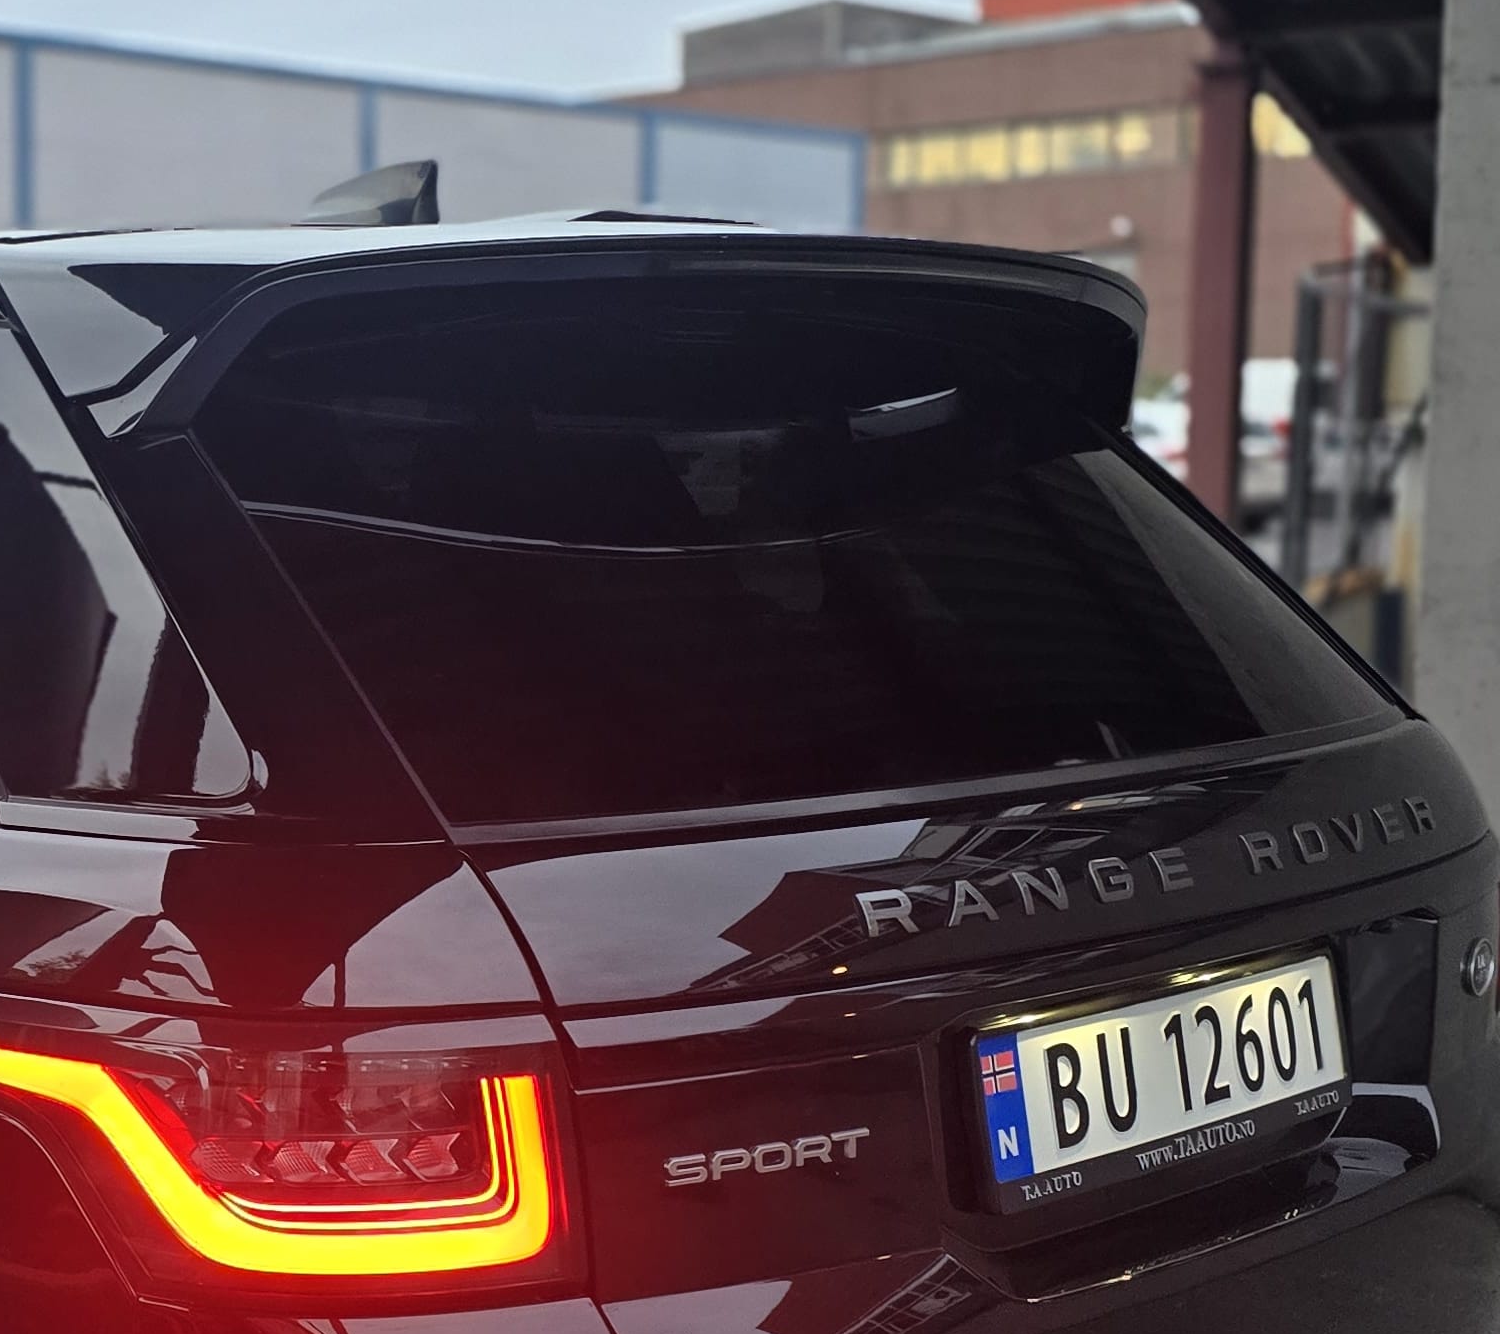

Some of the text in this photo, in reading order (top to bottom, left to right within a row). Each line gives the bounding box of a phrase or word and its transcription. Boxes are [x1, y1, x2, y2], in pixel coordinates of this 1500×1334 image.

[855, 795, 1437, 938] RANGE ROVER
[1043, 979, 1326, 1149] BU 12601
[664, 1128, 870, 1188] SPORT
[998, 1126, 1019, 1161] N
